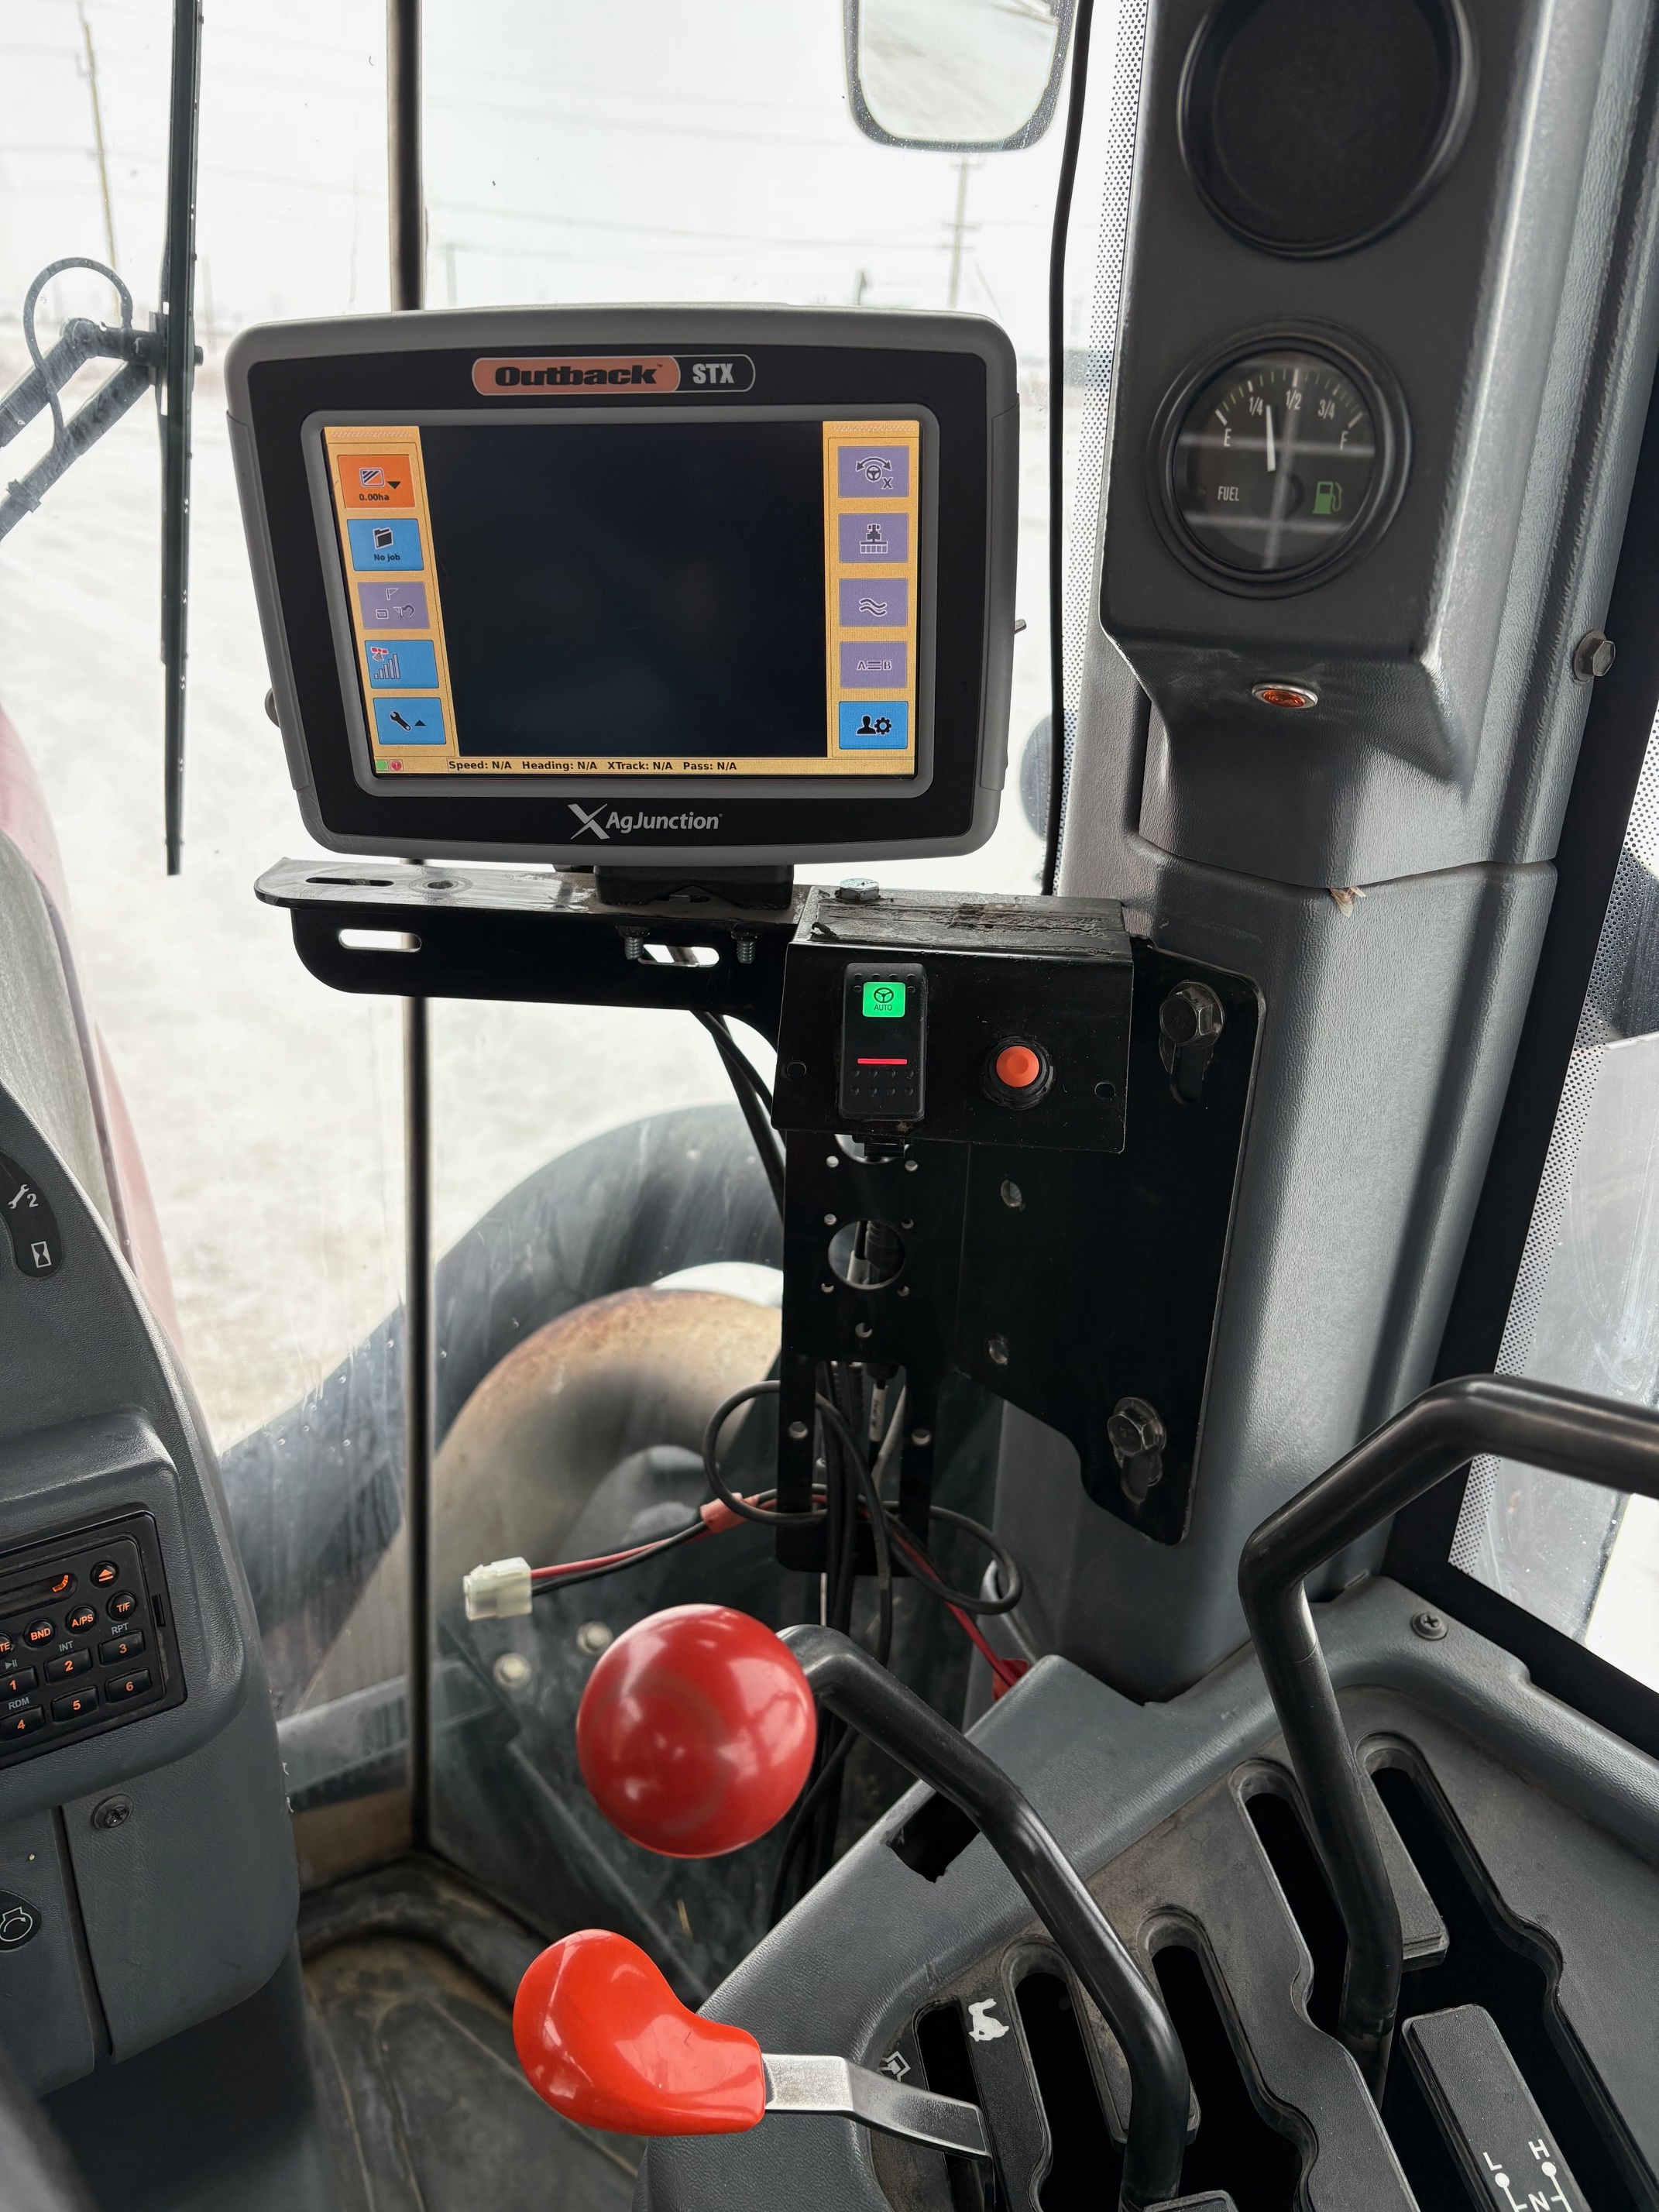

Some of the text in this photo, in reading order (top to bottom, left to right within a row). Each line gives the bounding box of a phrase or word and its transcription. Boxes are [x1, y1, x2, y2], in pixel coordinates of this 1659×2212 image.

[495, 363, 734, 386] Outback STX
[1249, 397, 1263, 415] 1/4
[1286, 390, 1301, 410] 1/2
[1318, 400, 1334, 419] 3/4
[1224, 428, 1231, 447] E
[1340, 431, 1348, 451] F
[1218, 486, 1239, 501] FUEL
[449, 761, 488, 771] Speed:
[492, 761, 512, 770] N/A
[522, 761, 573, 771] Heading:
[578, 761, 597, 770] N/A
[717, 762, 737, 771] N/A
[27, 1194, 38, 1207] 2
[117, 1602, 130, 1612] T/F
[72, 1614, 93, 1627] A/PS
[31, 1627, 50, 1640] BND
[112, 1623, 128, 1634] RPT
[59, 1641, 73, 1651] INT
[119, 1644, 127, 1653] 3
[65, 1661, 73, 1671] 2
[10, 1680, 16, 1690] 1
[126, 1681, 133, 1691] 6
[9, 1697, 29, 1709] RDM
[74, 1700, 81, 1710] 5
[18, 1719, 25, 1729] 4
[1483, 2139, 1550, 2170] L H
[1528, 2191, 1550, 2212] N
